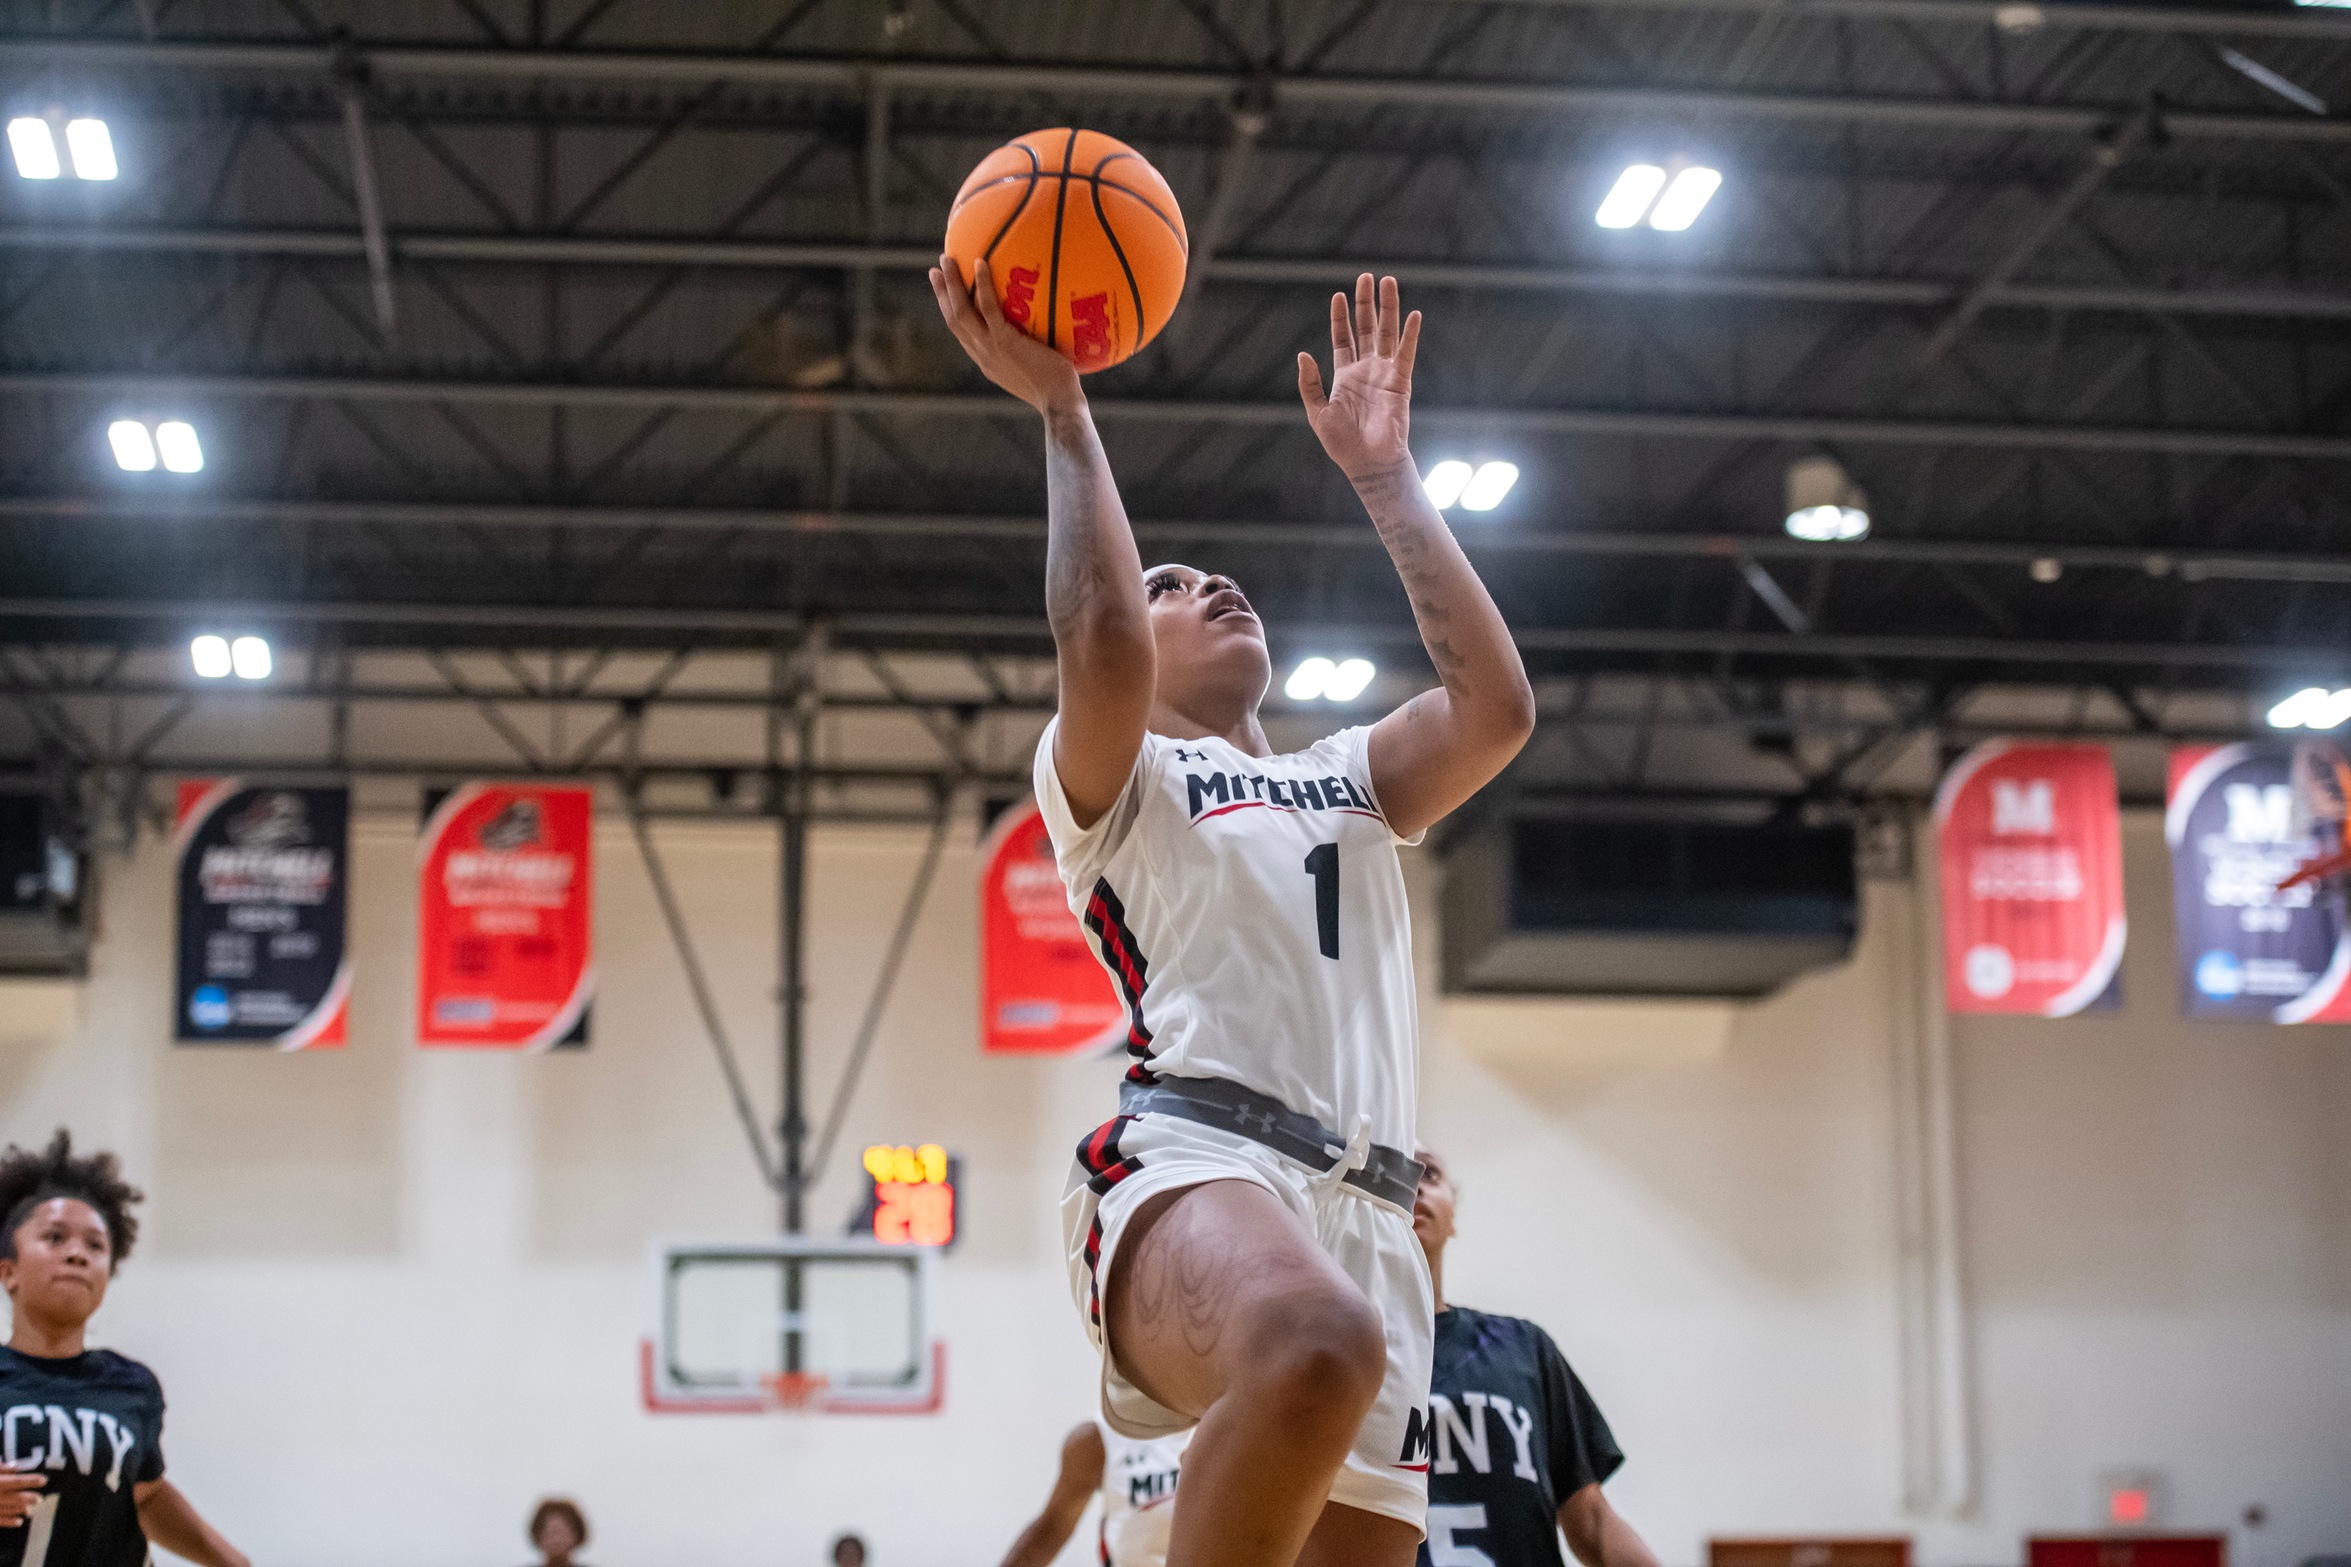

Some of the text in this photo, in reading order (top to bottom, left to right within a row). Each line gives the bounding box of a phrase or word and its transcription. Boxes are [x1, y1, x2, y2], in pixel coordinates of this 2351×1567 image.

[1304, 842, 1340, 961] 1
[0, 1404, 136, 1494] CNY
[1427, 1503, 1497, 1567] 5
